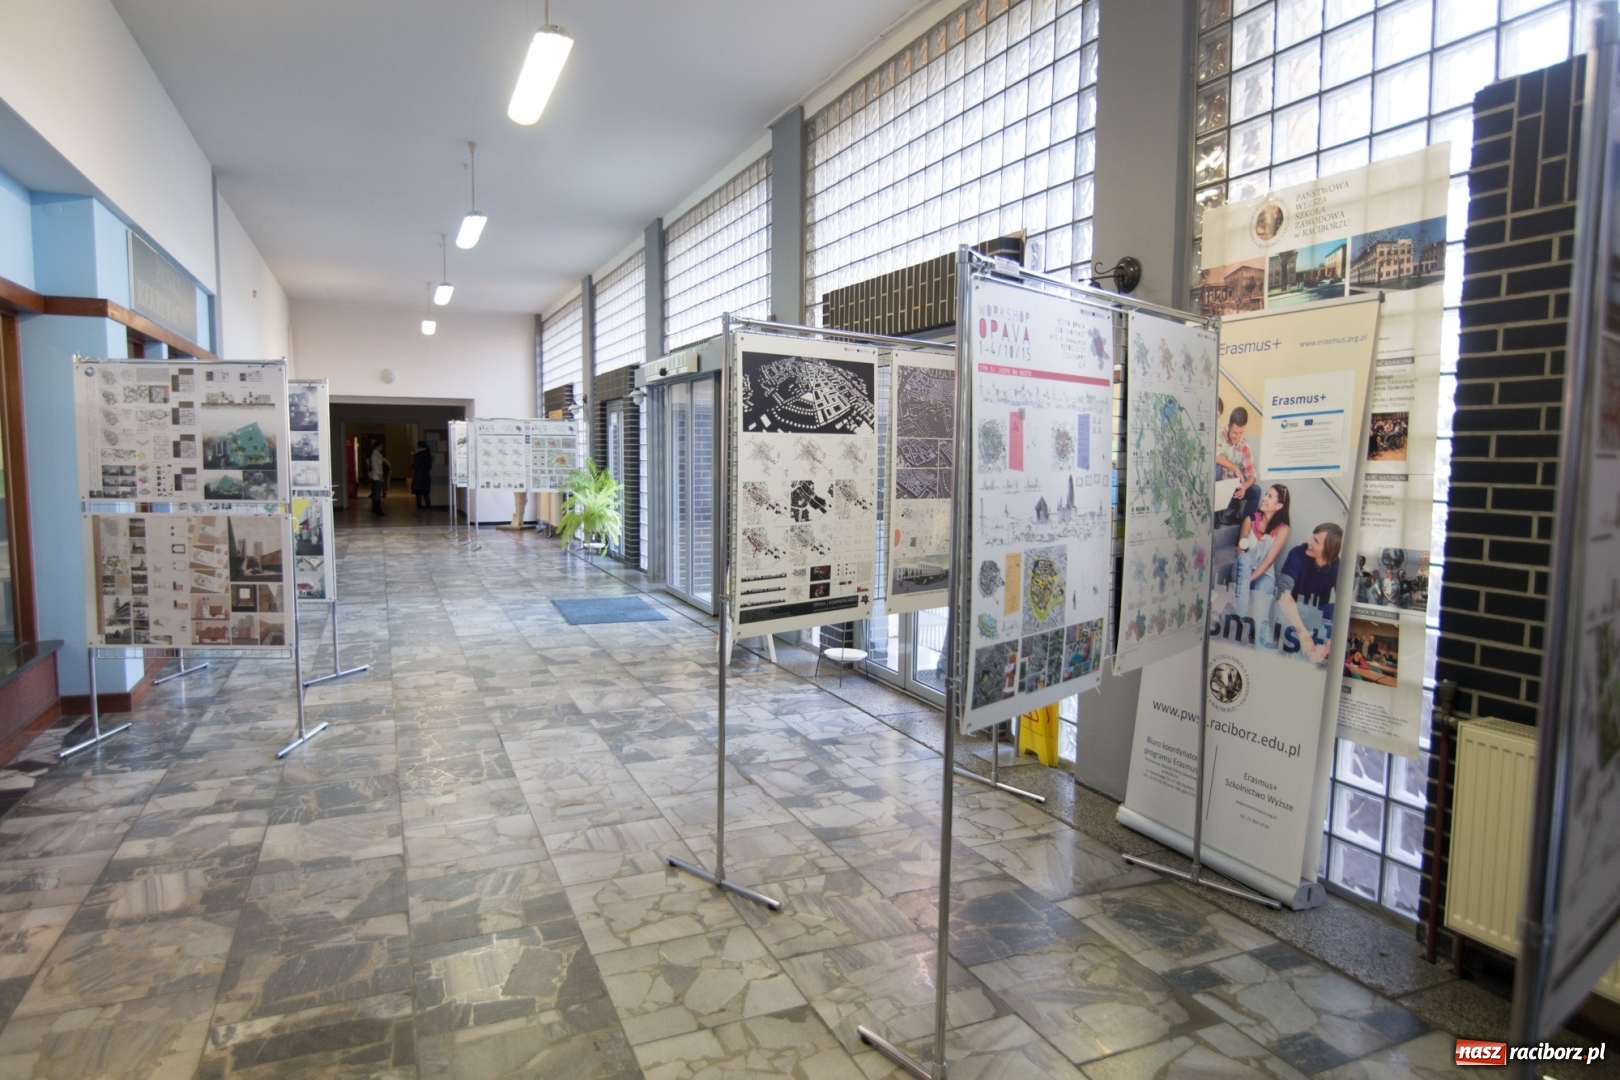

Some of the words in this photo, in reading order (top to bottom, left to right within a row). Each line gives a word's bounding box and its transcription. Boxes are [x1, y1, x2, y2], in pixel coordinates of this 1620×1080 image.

[1295, 181, 1350, 202] PAŃSTWOWA
[1295, 196, 1328, 211] WYŻSZA
[1294, 206, 1327, 221] SZKOŁA
[1294, 211, 1346, 230] ZAWODOWA
[1302, 219, 1350, 237] RACIBORZU
[978, 302, 1031, 324] WORKSHOP
[979, 318, 1031, 346] OPAVA
[1299, 333, 1368, 348] www.erasmus.org.pl
[979, 341, 1031, 362] 1-4/10/15
[1219, 338, 1282, 356] Erasmus+
[1272, 394, 1327, 406] Erasmus+
[1152, 700, 1302, 758] www.pws.raciborz.edu.pl
[1146, 736, 1162, 748] Biuro
[1143, 748, 1172, 764] programu
[1243, 772, 1278, 791] Erasmus+
[1225, 778, 1266, 800] Szkolnictwo
[1267, 794, 1294, 812] Wyższe
